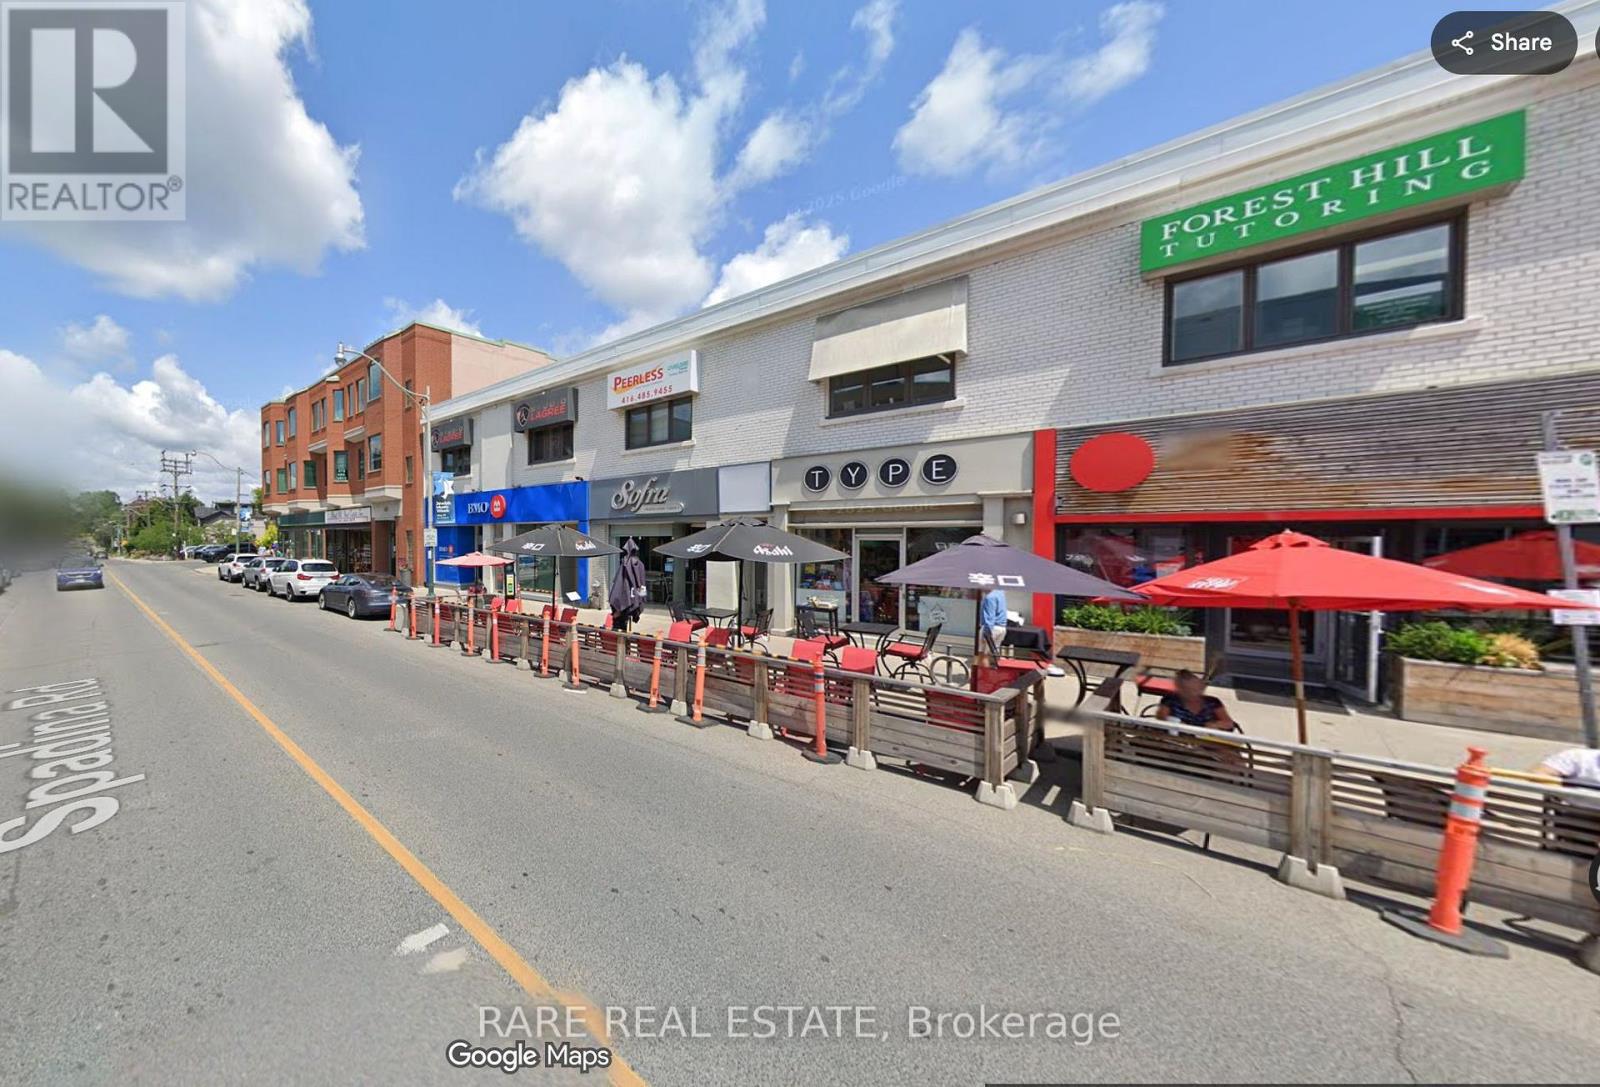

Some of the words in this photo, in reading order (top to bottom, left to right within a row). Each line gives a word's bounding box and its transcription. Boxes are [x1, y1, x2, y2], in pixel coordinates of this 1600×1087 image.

[1162, 177, 1331, 241] FOREST
[1350, 135, 1492, 190] HILL
[1160, 160, 1492, 258] TUTORING
[613, 367, 664, 391] PEERLESS
[810, 459, 947, 488] TYPE
[467, 501, 489, 514] BMO
[611, 476, 669, 512] Sofra
